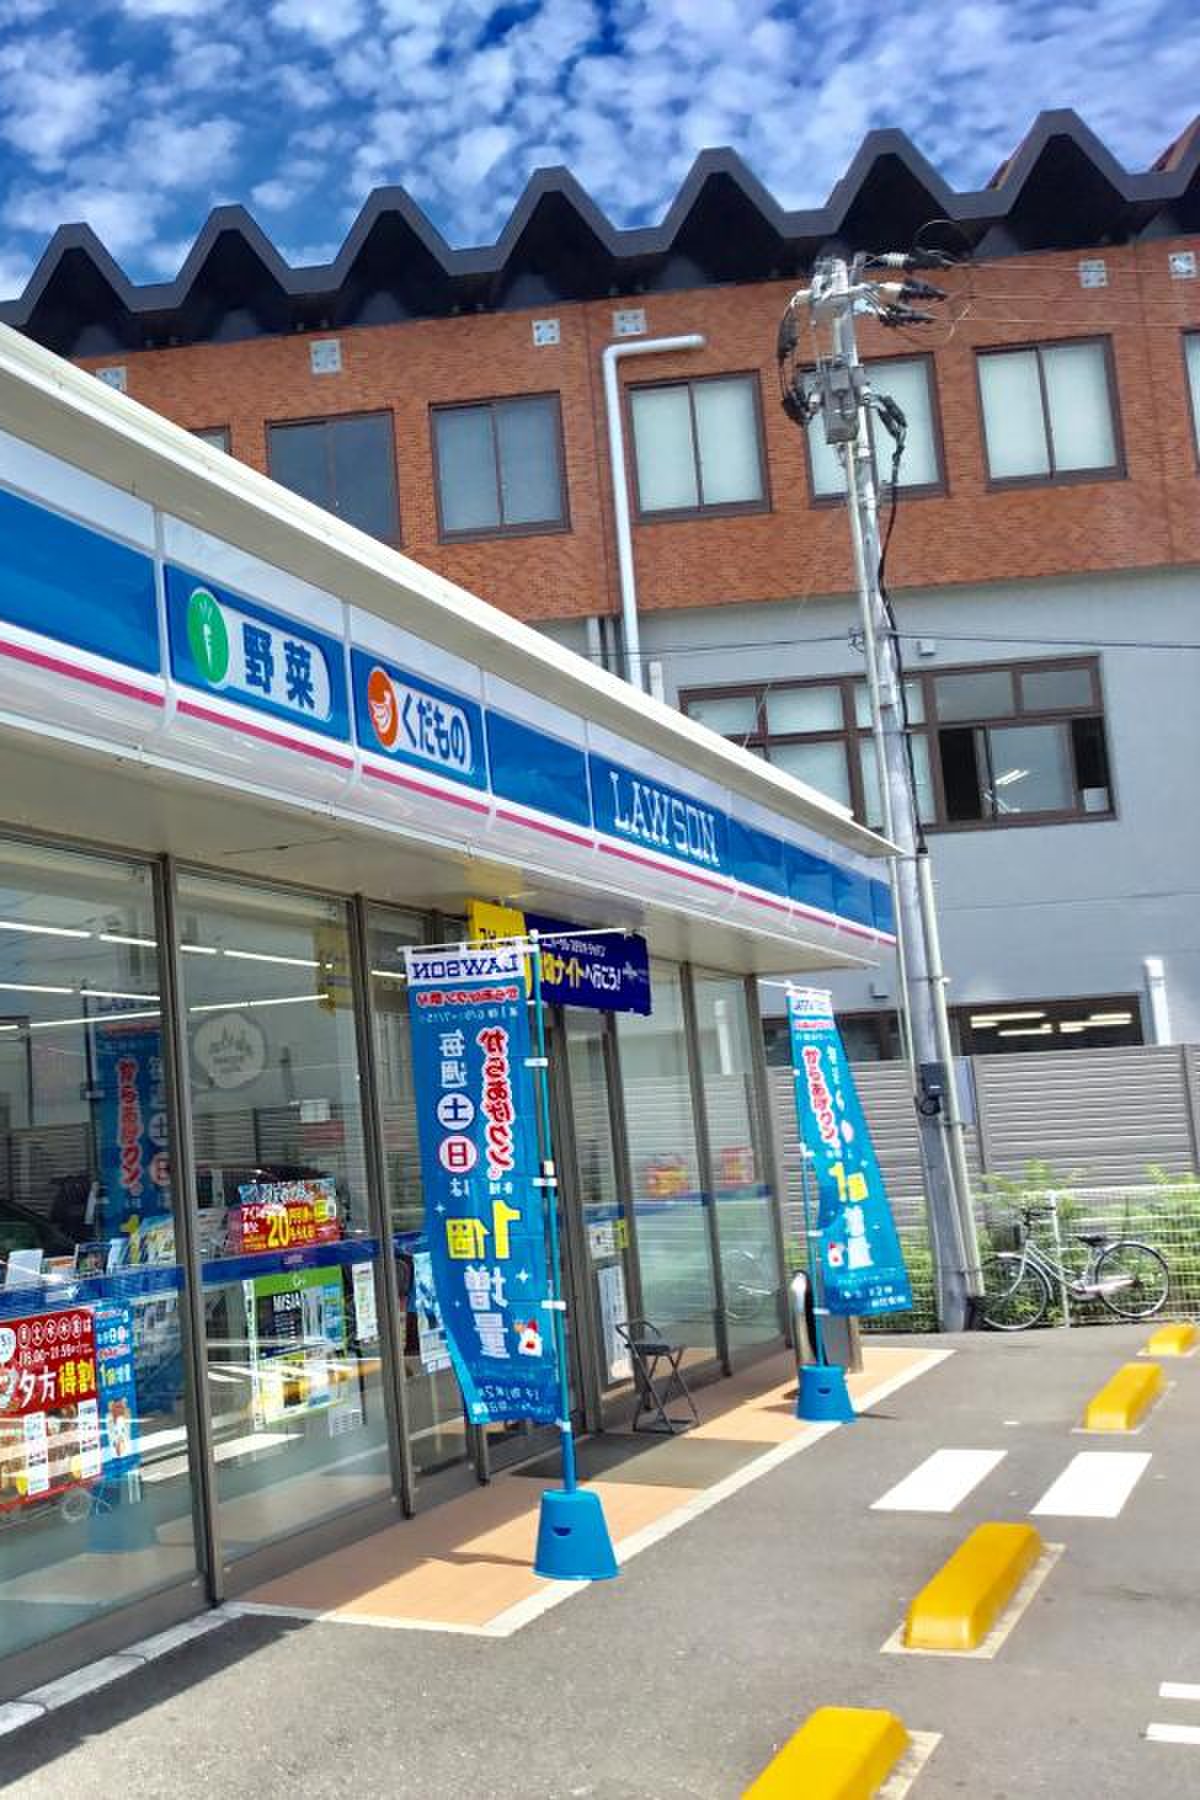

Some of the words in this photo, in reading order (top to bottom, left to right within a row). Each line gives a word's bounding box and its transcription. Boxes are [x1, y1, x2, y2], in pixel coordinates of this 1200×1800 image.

[242, 621, 314, 709] 野菜
[402, 693, 465, 765] くだもの
[609, 770, 719, 864] LAWSON
